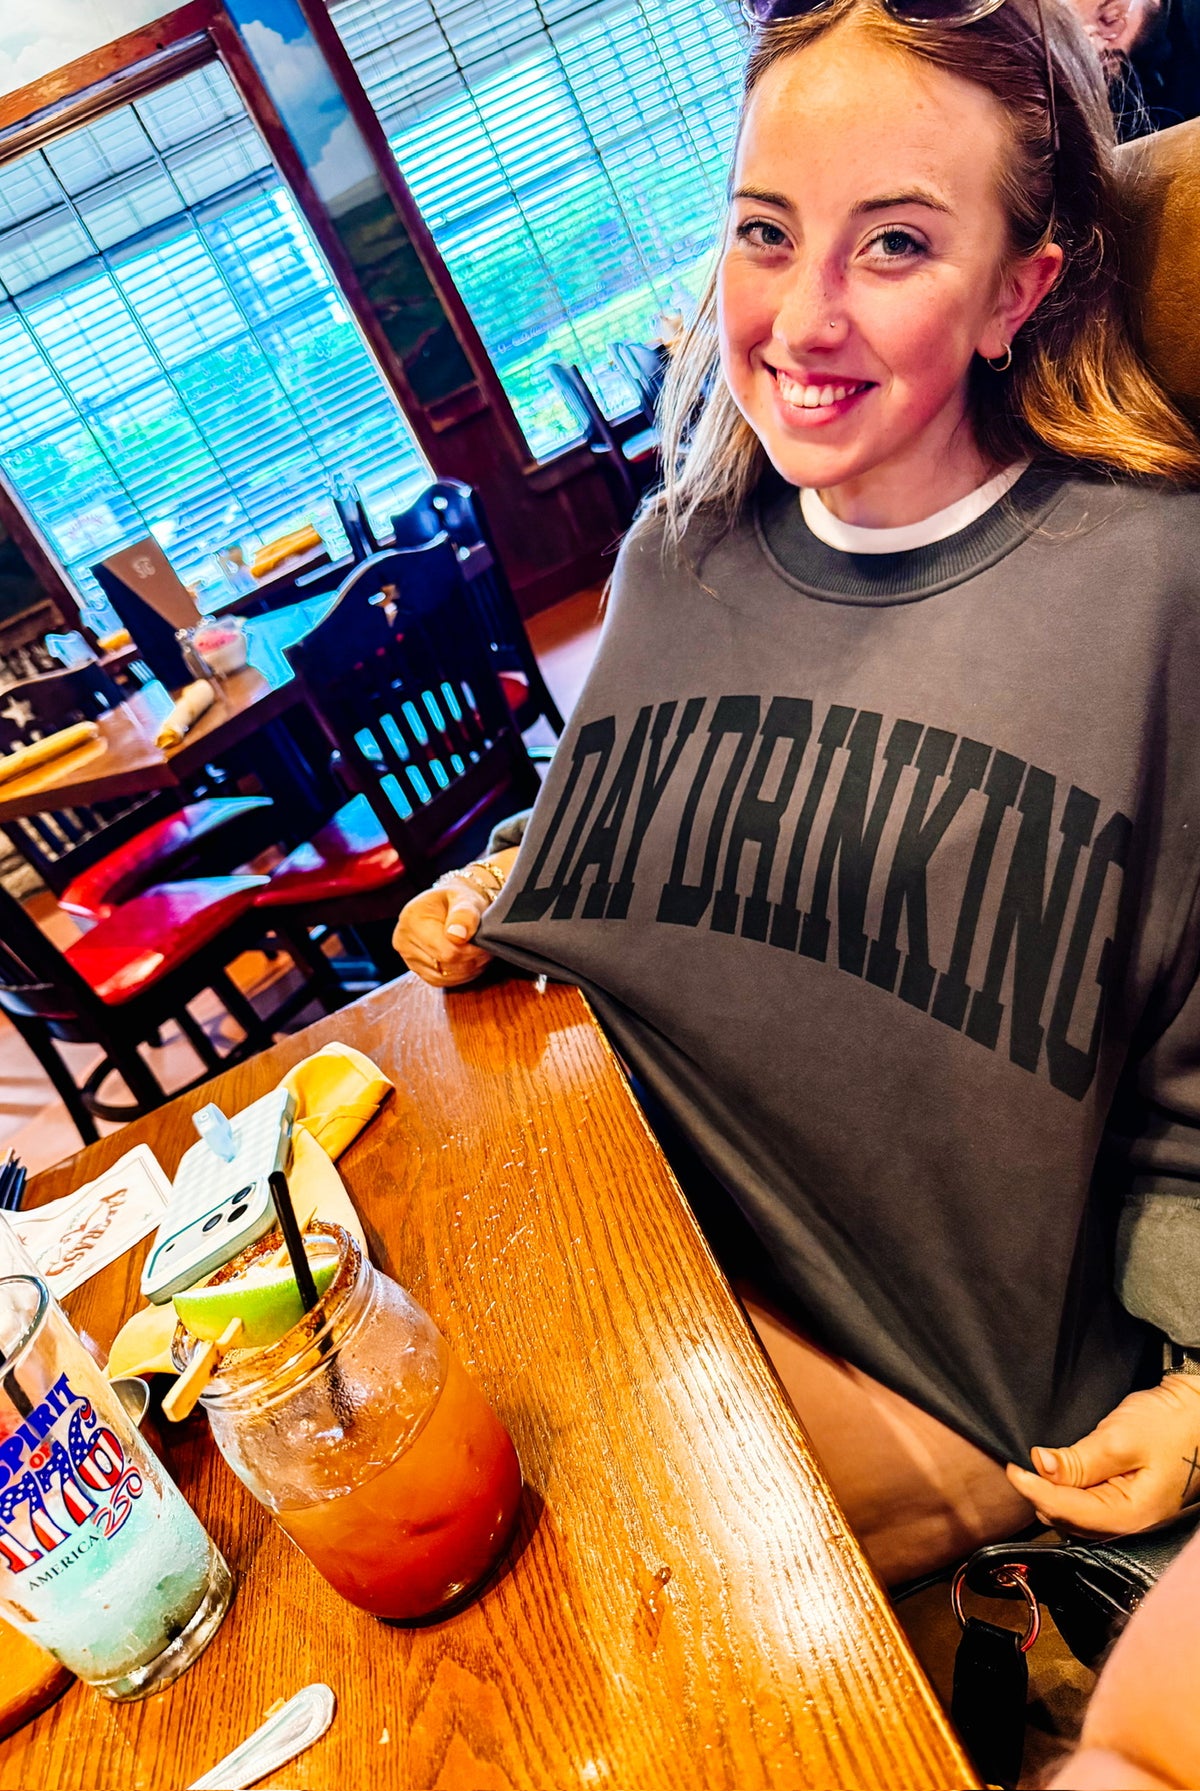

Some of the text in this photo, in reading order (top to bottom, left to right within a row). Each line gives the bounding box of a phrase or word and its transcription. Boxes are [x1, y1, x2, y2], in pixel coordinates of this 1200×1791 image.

[502, 696, 1133, 1101] DAY DRINKING
[0, 1397, 125, 1574] 1776
[28, 1466, 143, 1591] AMERICA 250
[29, 1441, 53, 1469] OF
